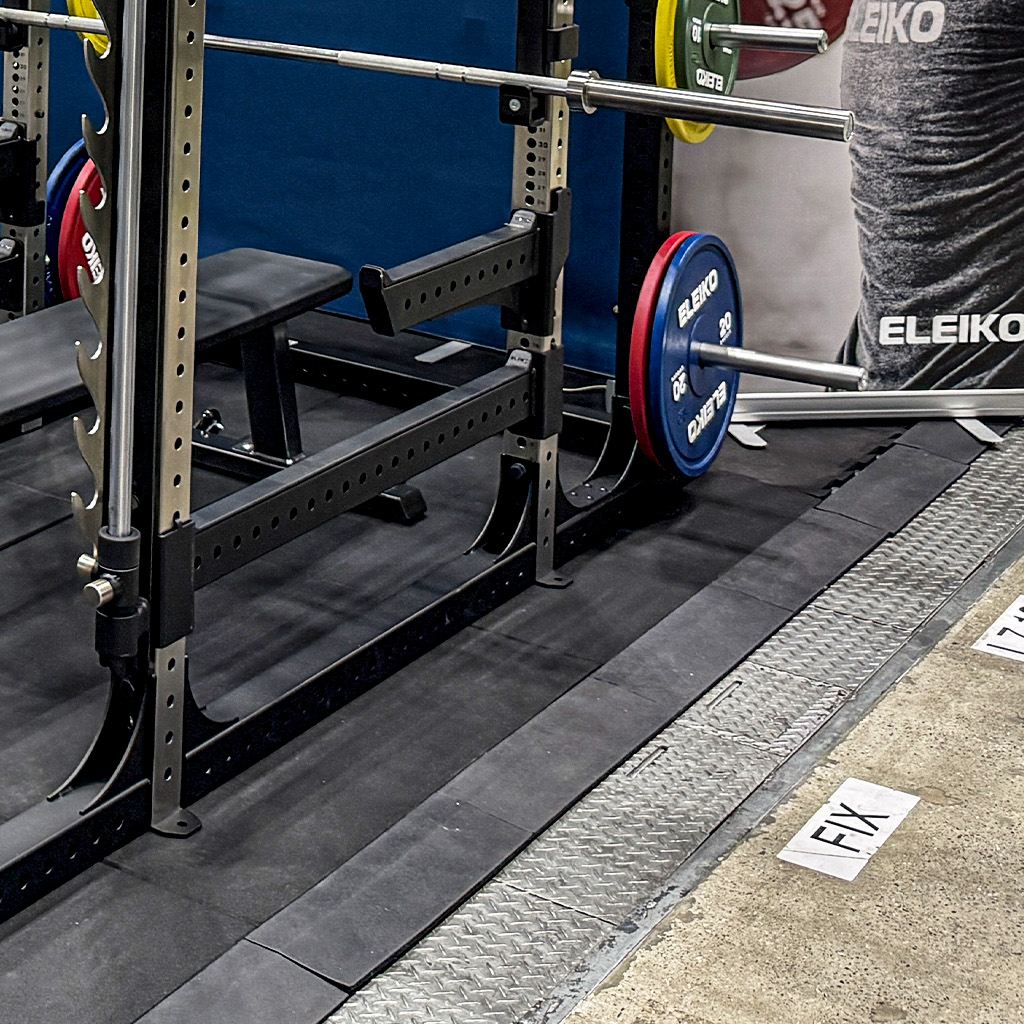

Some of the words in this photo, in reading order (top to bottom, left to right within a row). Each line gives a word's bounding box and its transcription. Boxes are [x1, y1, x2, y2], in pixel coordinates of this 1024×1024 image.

[678, 268, 719, 328] ELEIKO
[718, 312, 732, 338] 20
[879, 313, 1024, 346] ELEIKO
[687, 380, 728, 444] ELEIKO
[810, 802, 890, 854] FIX
